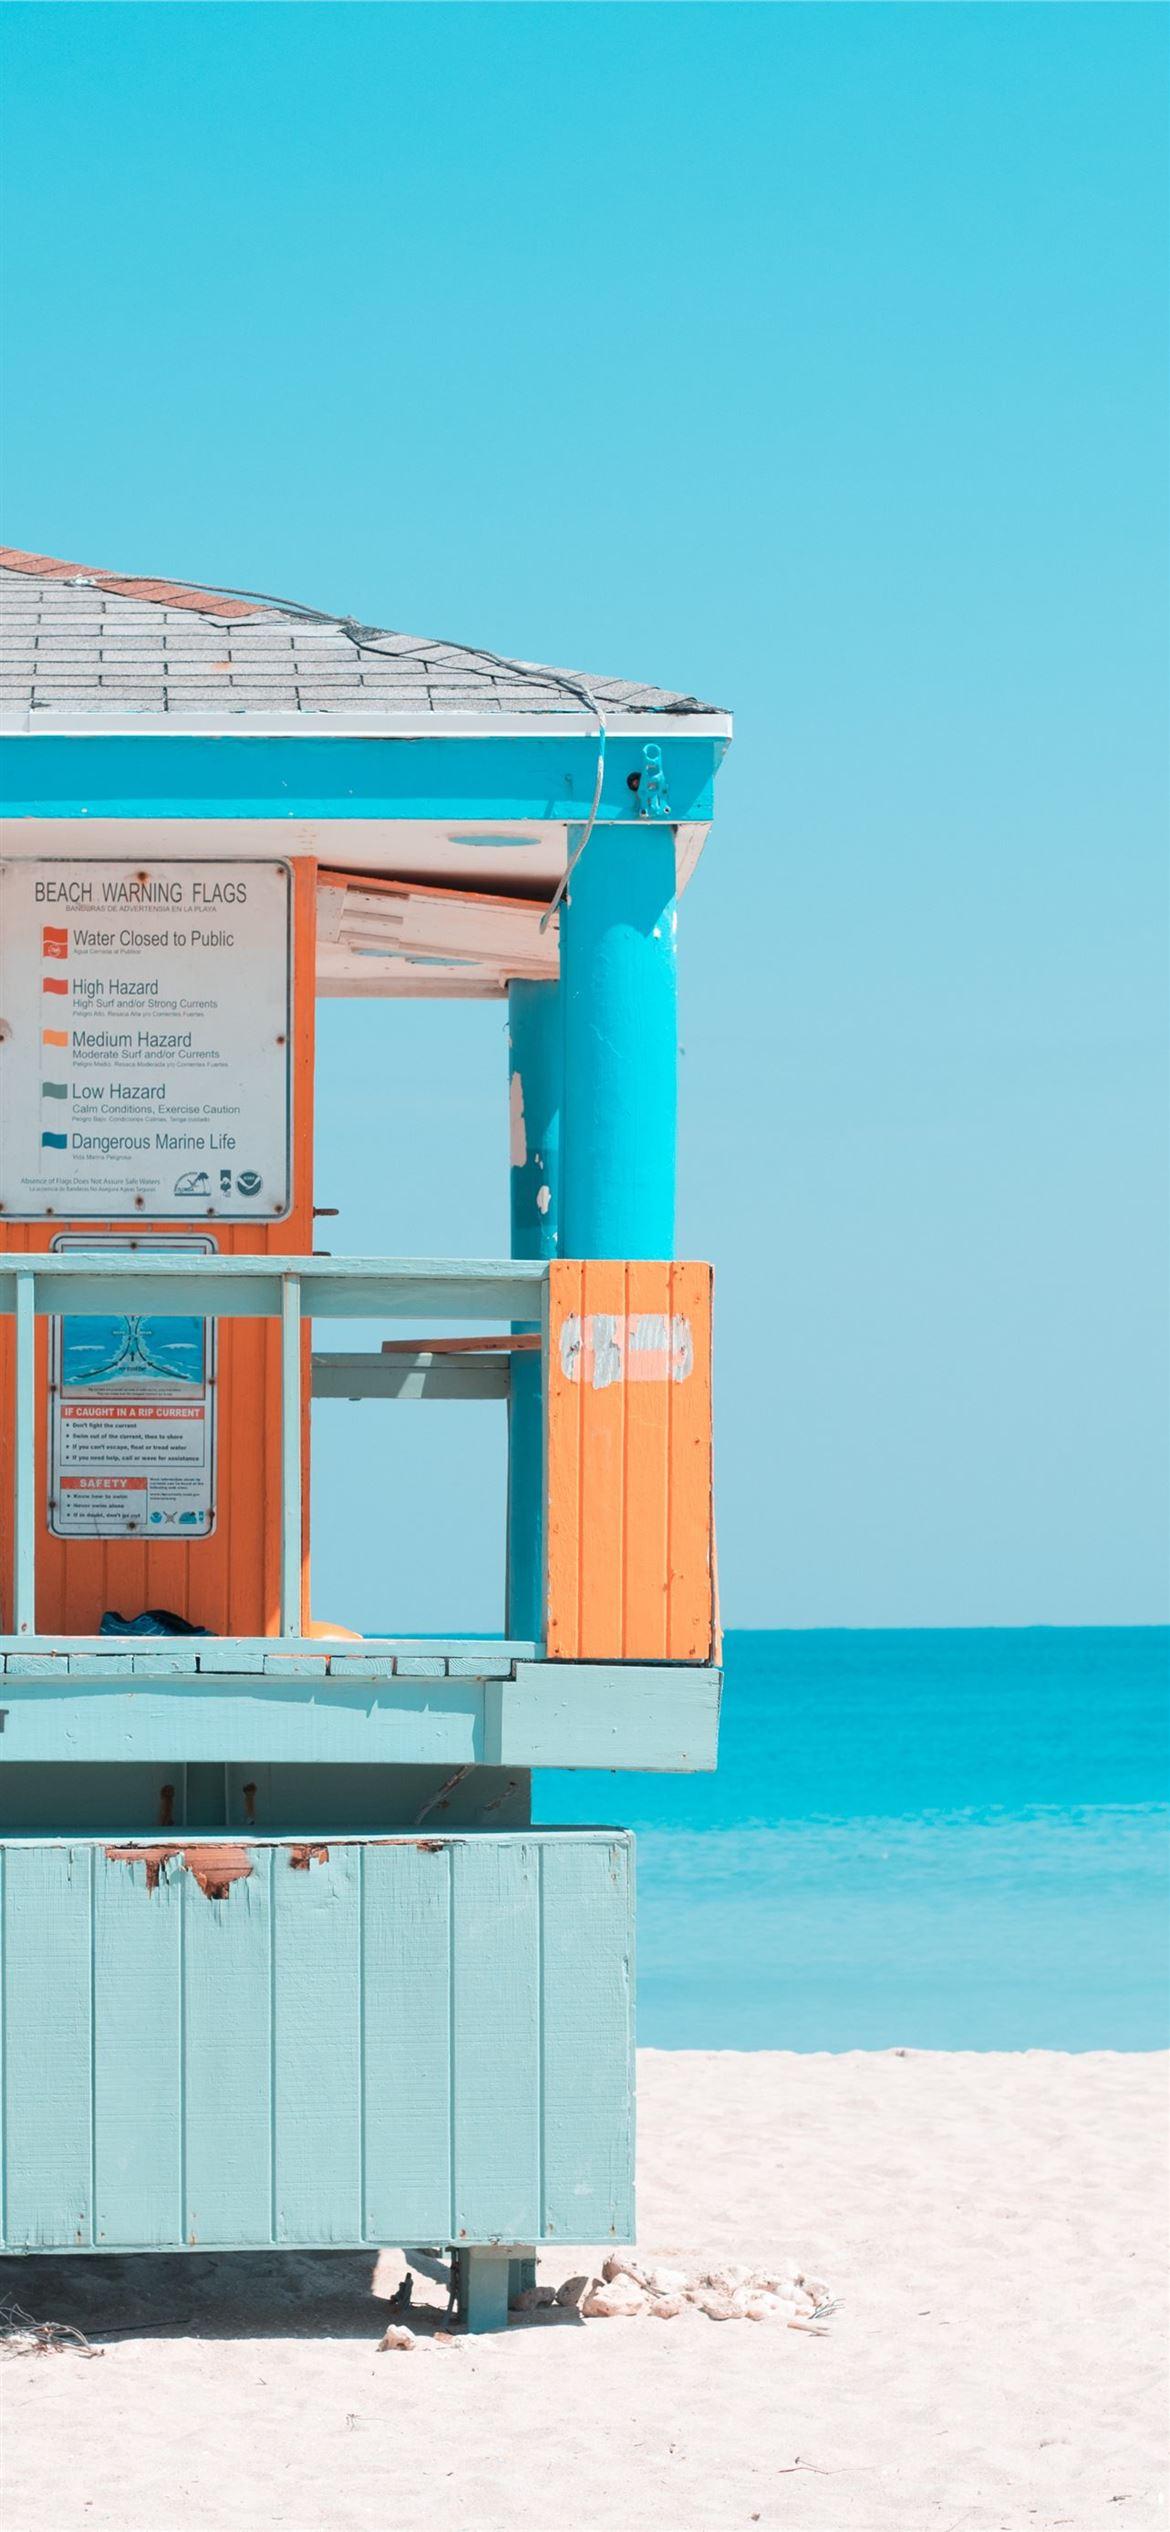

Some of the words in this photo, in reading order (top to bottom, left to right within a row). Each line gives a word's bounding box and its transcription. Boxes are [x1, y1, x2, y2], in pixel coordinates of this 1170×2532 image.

[35, 882, 92, 903] BEACH
[102, 882, 182, 903] WARNING
[192, 882, 247, 903] FLAGS
[73, 930, 115, 946] Water
[120, 930, 168, 946] Closed
[173, 930, 186, 946] to
[191, 930, 234, 946] Public
[72, 979, 104, 998] High
[109, 979, 158, 995] Hazard
[72, 999, 93, 1009] High
[96, 999, 114, 1008] Surf
[116, 999, 144, 1008] and/or
[148, 999, 176, 1009] Strong
[180, 999, 218, 1008] Currents
[72, 1031, 132, 1047] Medium
[138, 1031, 192, 1047] Hazard
[72, 1050, 118, 1059] Moderate
[121, 1050, 142, 1059] Surf
[144, 1050, 175, 1059] and/or
[178, 1050, 220, 1059] Currents
[72, 1084, 104, 1100] Low
[110, 1084, 166, 1100] Hazard
[72, 1104, 98, 1114] Calm
[100, 1104, 155, 1115] Conditions,
[158, 1104, 200, 1114] Exercise
[202, 1104, 240, 1114] Caution
[72, 1133, 150, 1152] Dangerous
[156, 1133, 204, 1150] Marine
[210, 1133, 236, 1150] Life
[64, 1408, 74, 1417] IF
[76, 1408, 114, 1417] CAUGHT
[117, 1408, 126, 1417] IN
[128, 1408, 136, 1417] A
[138, 1408, 154, 1417] RIP
[156, 1408, 200, 1417] CURRENT
[80, 1479, 127, 1488] SAFETY
